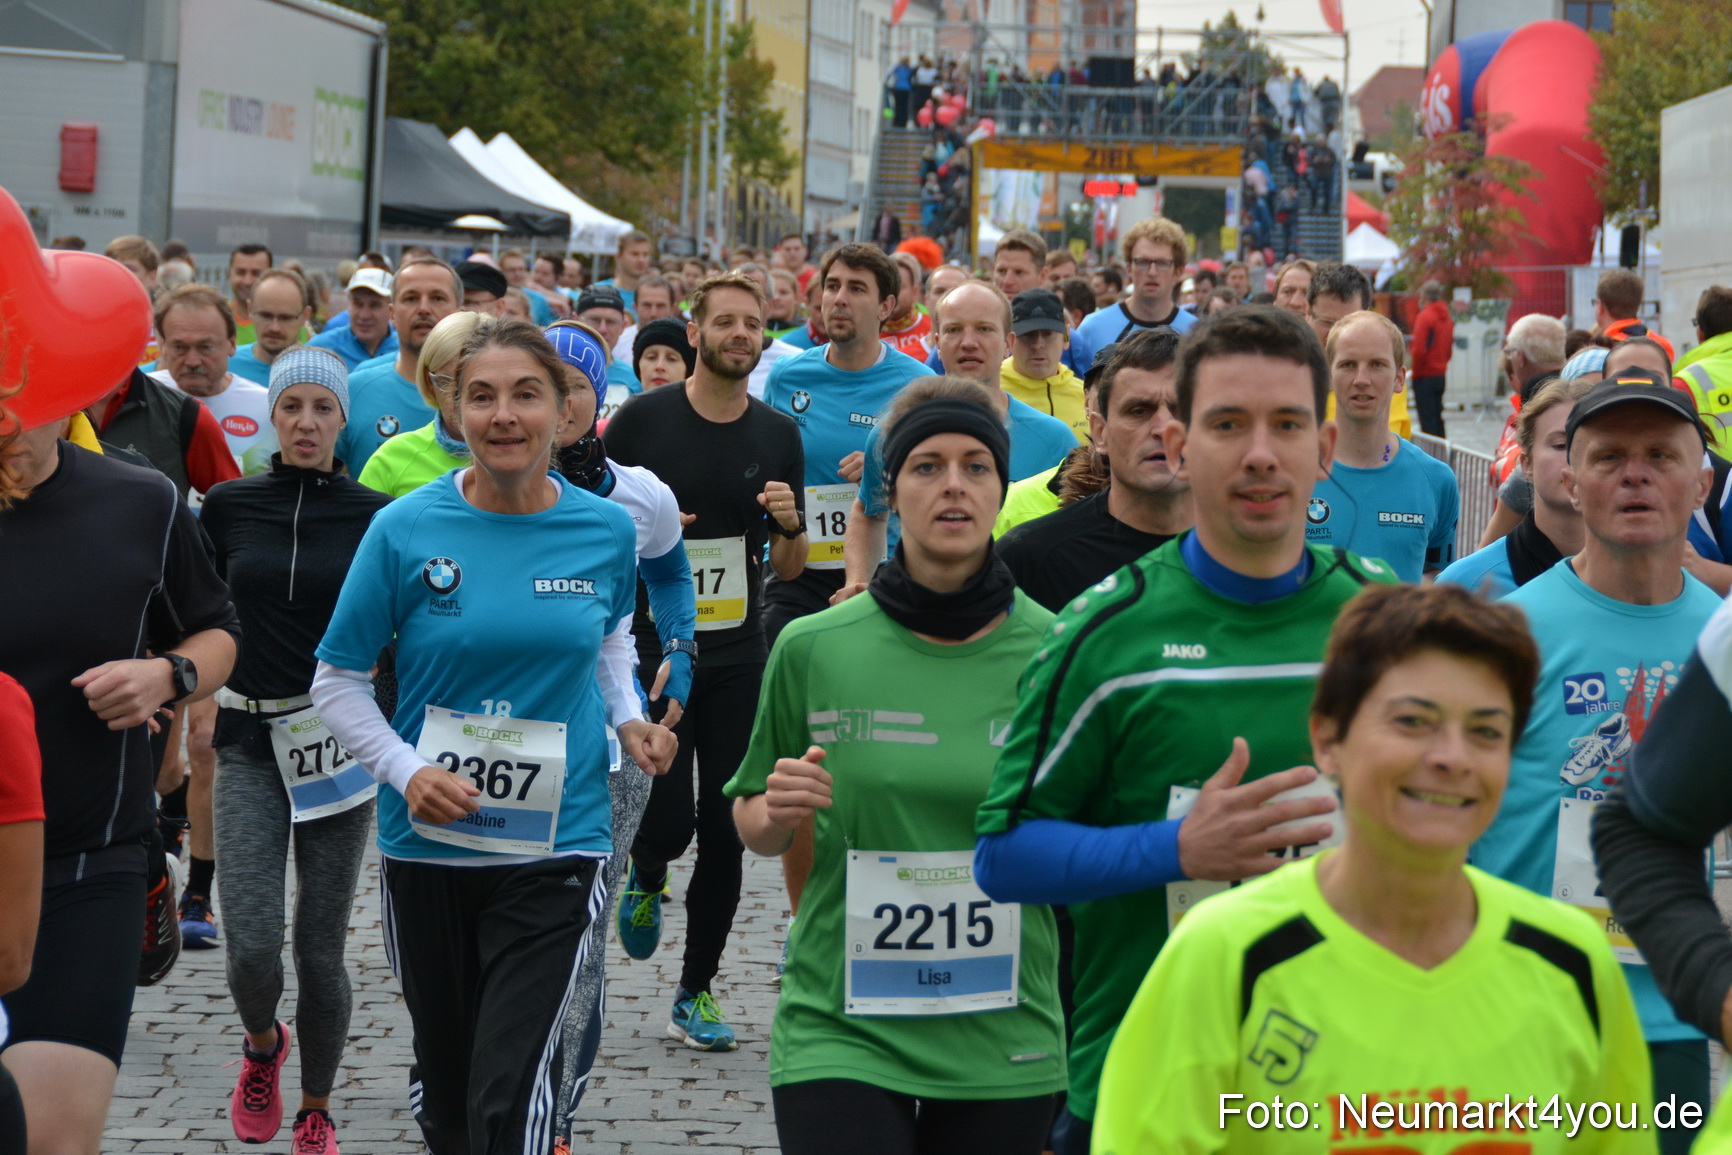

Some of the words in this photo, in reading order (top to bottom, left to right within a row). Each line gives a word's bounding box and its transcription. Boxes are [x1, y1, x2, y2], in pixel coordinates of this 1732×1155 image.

[1083, 147, 1140, 171] ZIEL
[225, 419, 255, 432] Hervis
[825, 492, 856, 500] BOCK
[1378, 512, 1424, 525] BOCK
[688, 548, 721, 556] BOCK
[425, 558, 458, 571] BMW
[534, 579, 597, 595] BOCK
[429, 598, 462, 610] PARTL
[428, 607, 462, 617] Neumarkt
[1162, 644, 1207, 658] JAKO
[1565, 678, 1605, 704] 20
[481, 699, 512, 718] 18
[1585, 699, 1621, 717] jahre
[476, 726, 523, 743] BOCK
[436, 751, 541, 801] 2367
[914, 866, 971, 881] BOCK
[1178, 895, 1186, 904] C
[873, 900, 994, 950] 2215
[856, 944, 862, 953] D
[918, 969, 952, 985] Lisa
